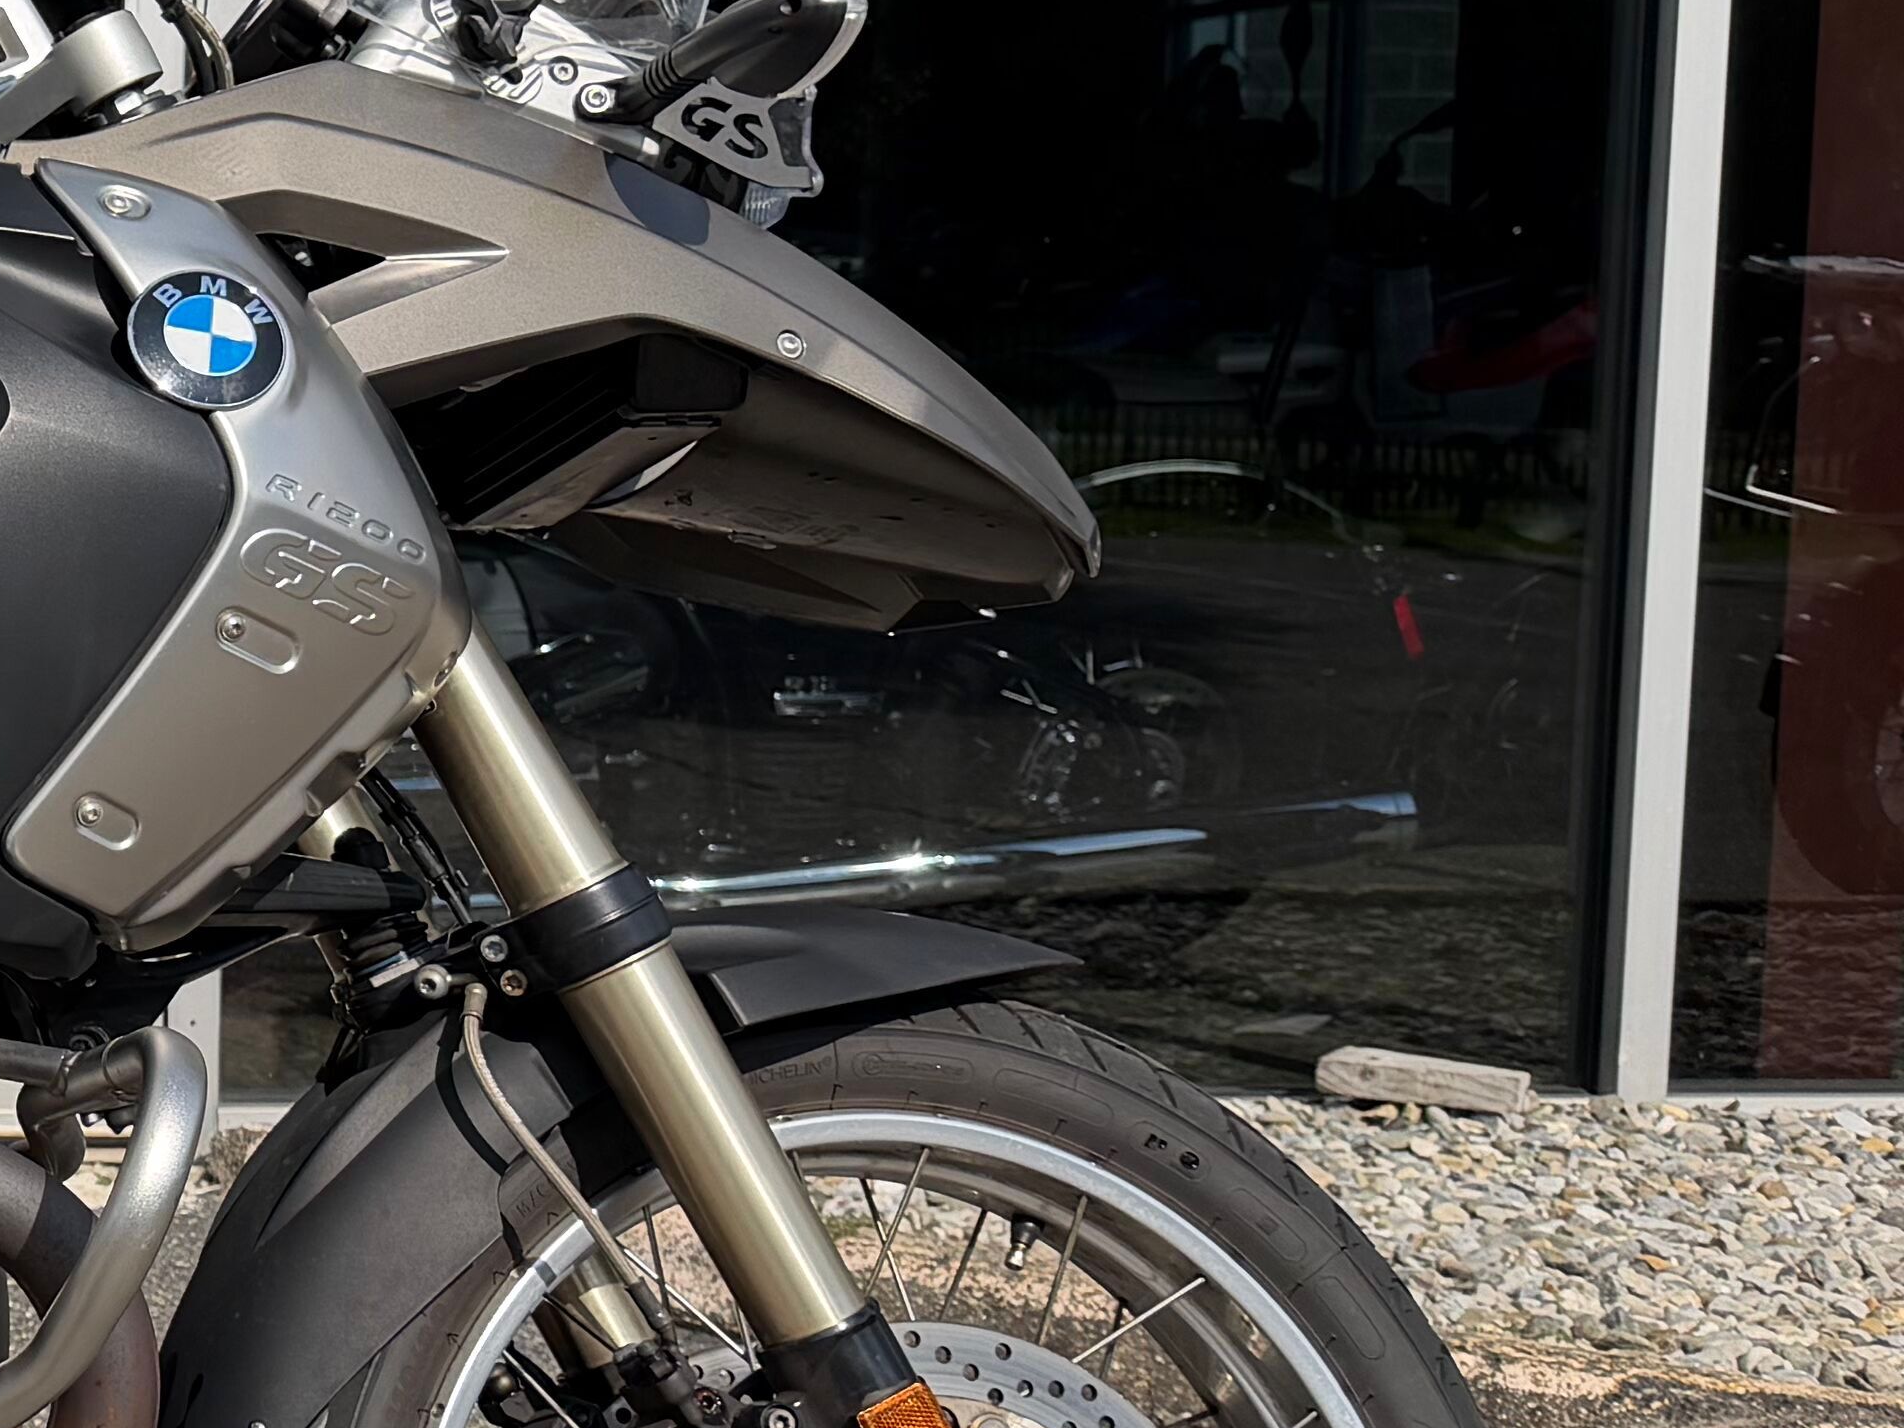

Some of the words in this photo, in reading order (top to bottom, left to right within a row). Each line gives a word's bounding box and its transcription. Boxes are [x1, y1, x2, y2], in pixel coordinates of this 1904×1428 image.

[680, 96, 770, 160] GS
[153, 274, 273, 327] BMW
[264, 473, 427, 562] R1200
[239, 527, 415, 636] GS
